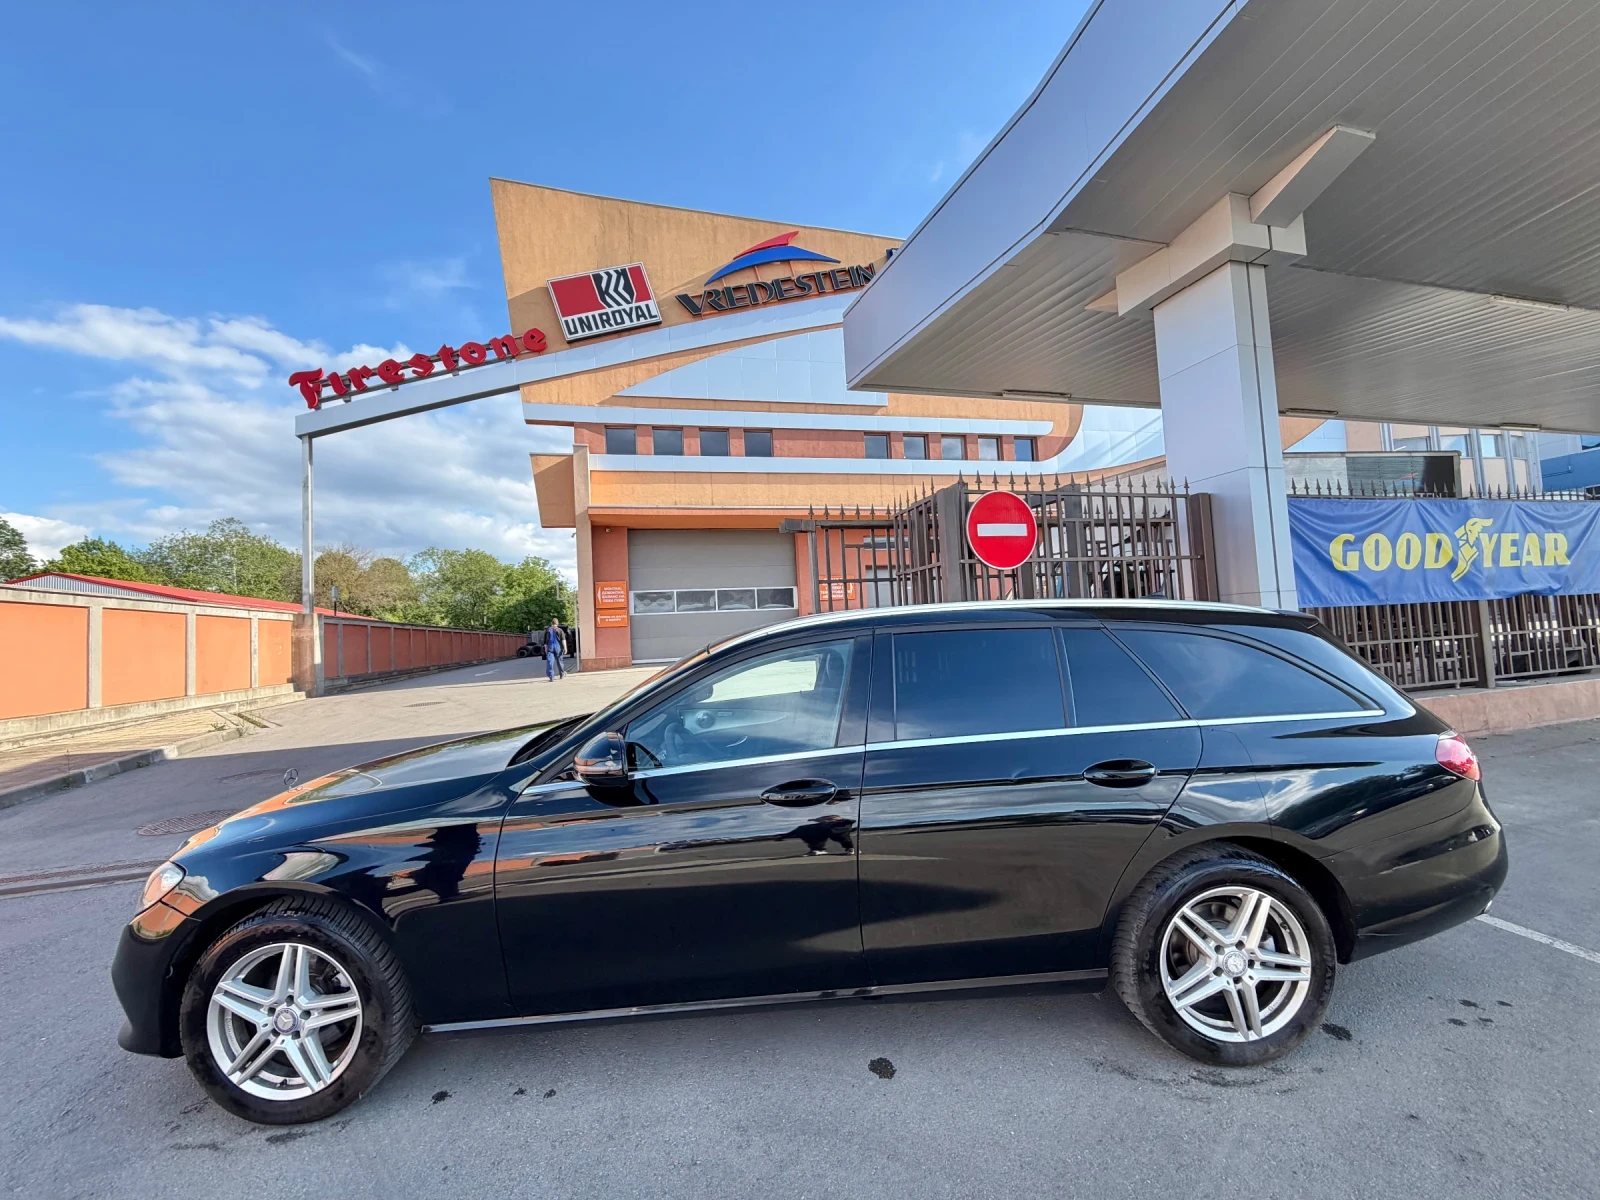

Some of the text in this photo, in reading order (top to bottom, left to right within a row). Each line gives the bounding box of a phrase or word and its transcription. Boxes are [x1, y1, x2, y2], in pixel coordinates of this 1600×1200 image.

[674, 263, 877, 316] VREDESTEIN
[564, 303, 658, 336] UNIROYAL
[288, 327, 548, 410] Firestone
